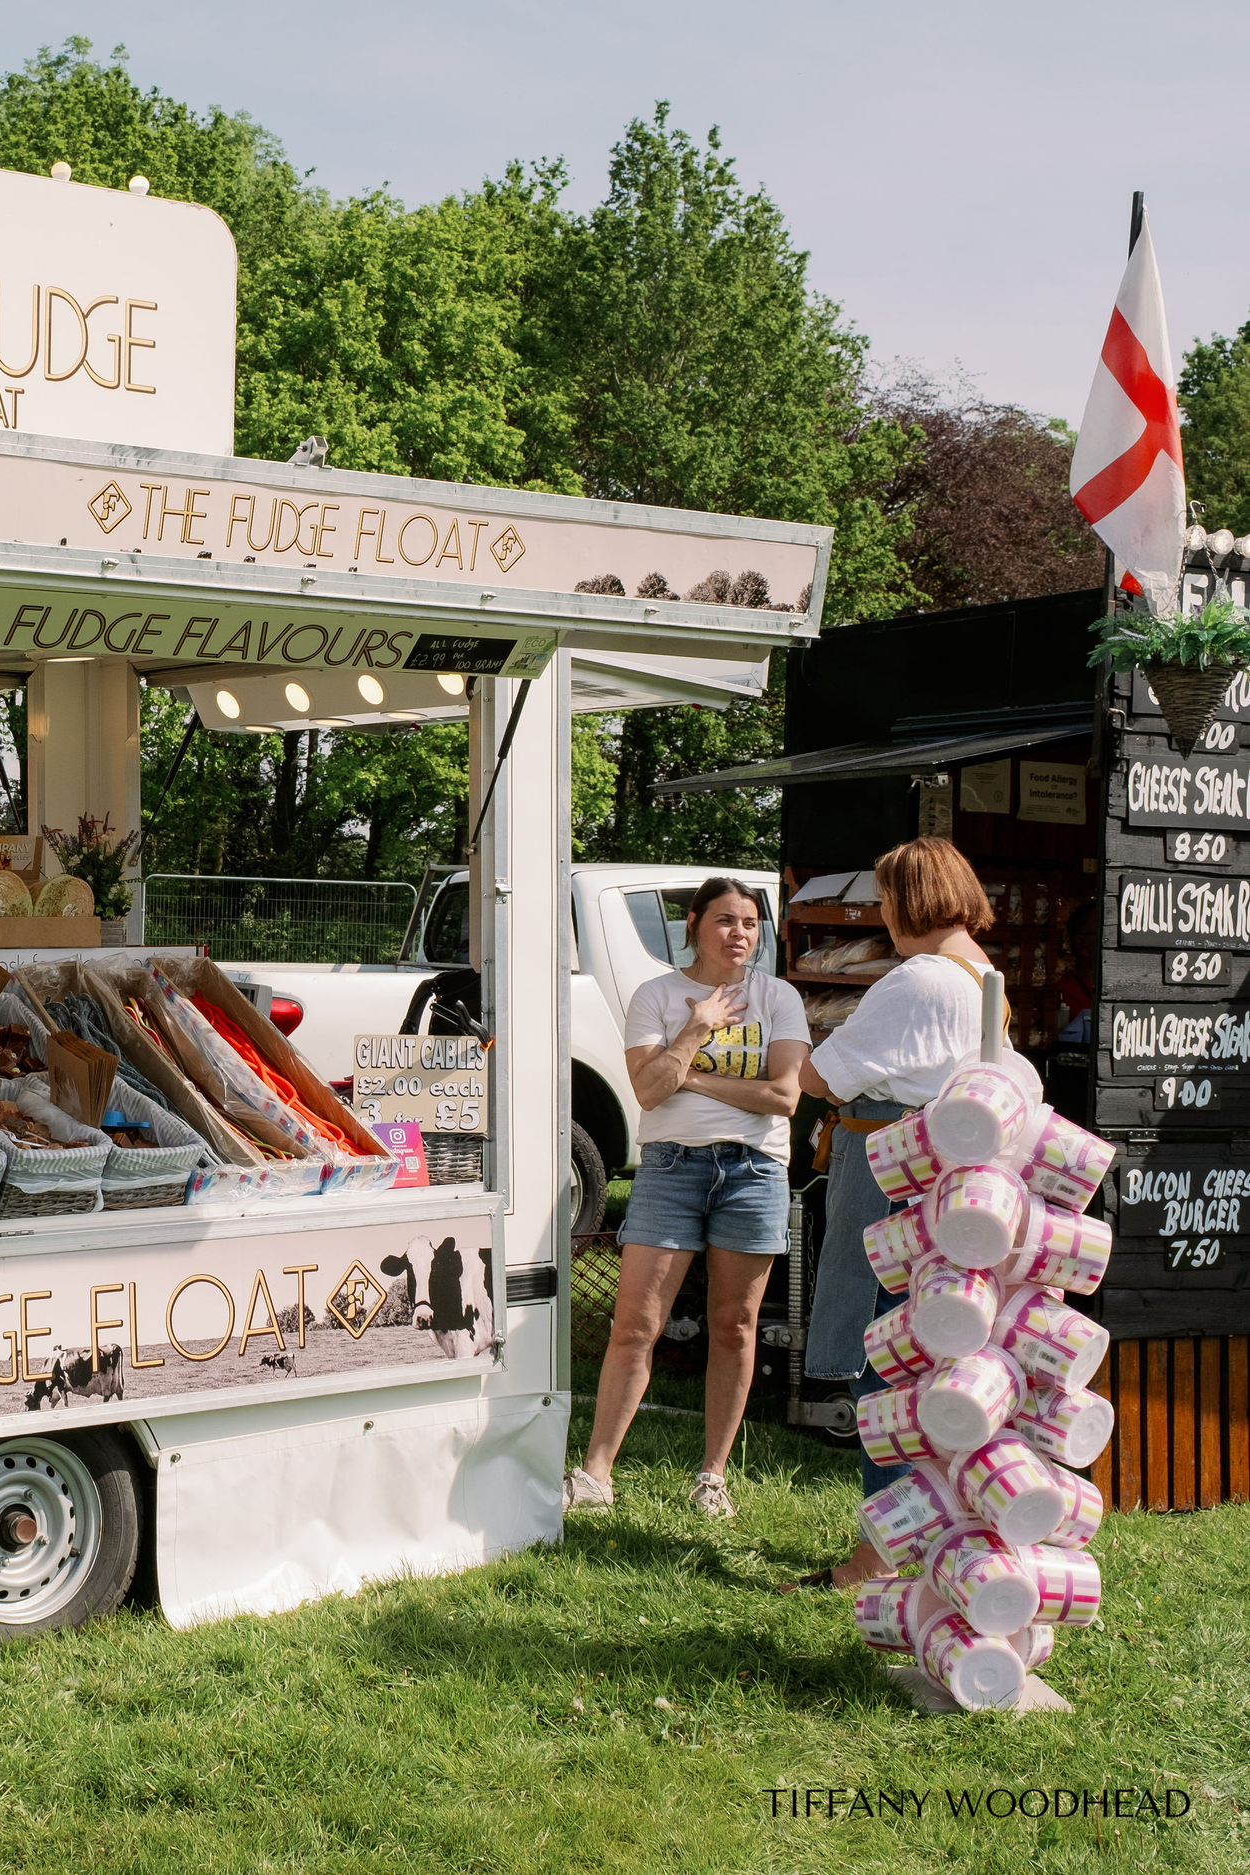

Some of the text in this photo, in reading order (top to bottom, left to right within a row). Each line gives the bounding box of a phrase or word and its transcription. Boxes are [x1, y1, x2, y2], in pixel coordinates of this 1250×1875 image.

[139, 483, 211, 545] THE
[225, 493, 340, 558] FUDGE
[353, 507, 489, 572] FLOAT
[3, 604, 171, 655] FUDGE
[173, 616, 414, 669] FLAVOURS
[430, 640, 447, 649] ALL
[525, 638, 546, 648] ECO
[455, 660, 471, 669] 100
[1029, 772, 1078, 787] Food Allergy
[1029, 789, 1078, 801] Intolerance?
[1128, 761, 1192, 814] CHEESE
[1194, 765, 1246, 817] STEAK
[356, 1037, 486, 1071] GIANT CABLES
[357, 1075, 484, 1097] £2.00 each
[360, 1098, 382, 1127] 3
[435, 1099, 481, 1131] £5
[1122, 1169, 1191, 1205] BACON
[1159, 1198, 1240, 1236] BURGER
[90, 1263, 319, 1373] FLOAT
